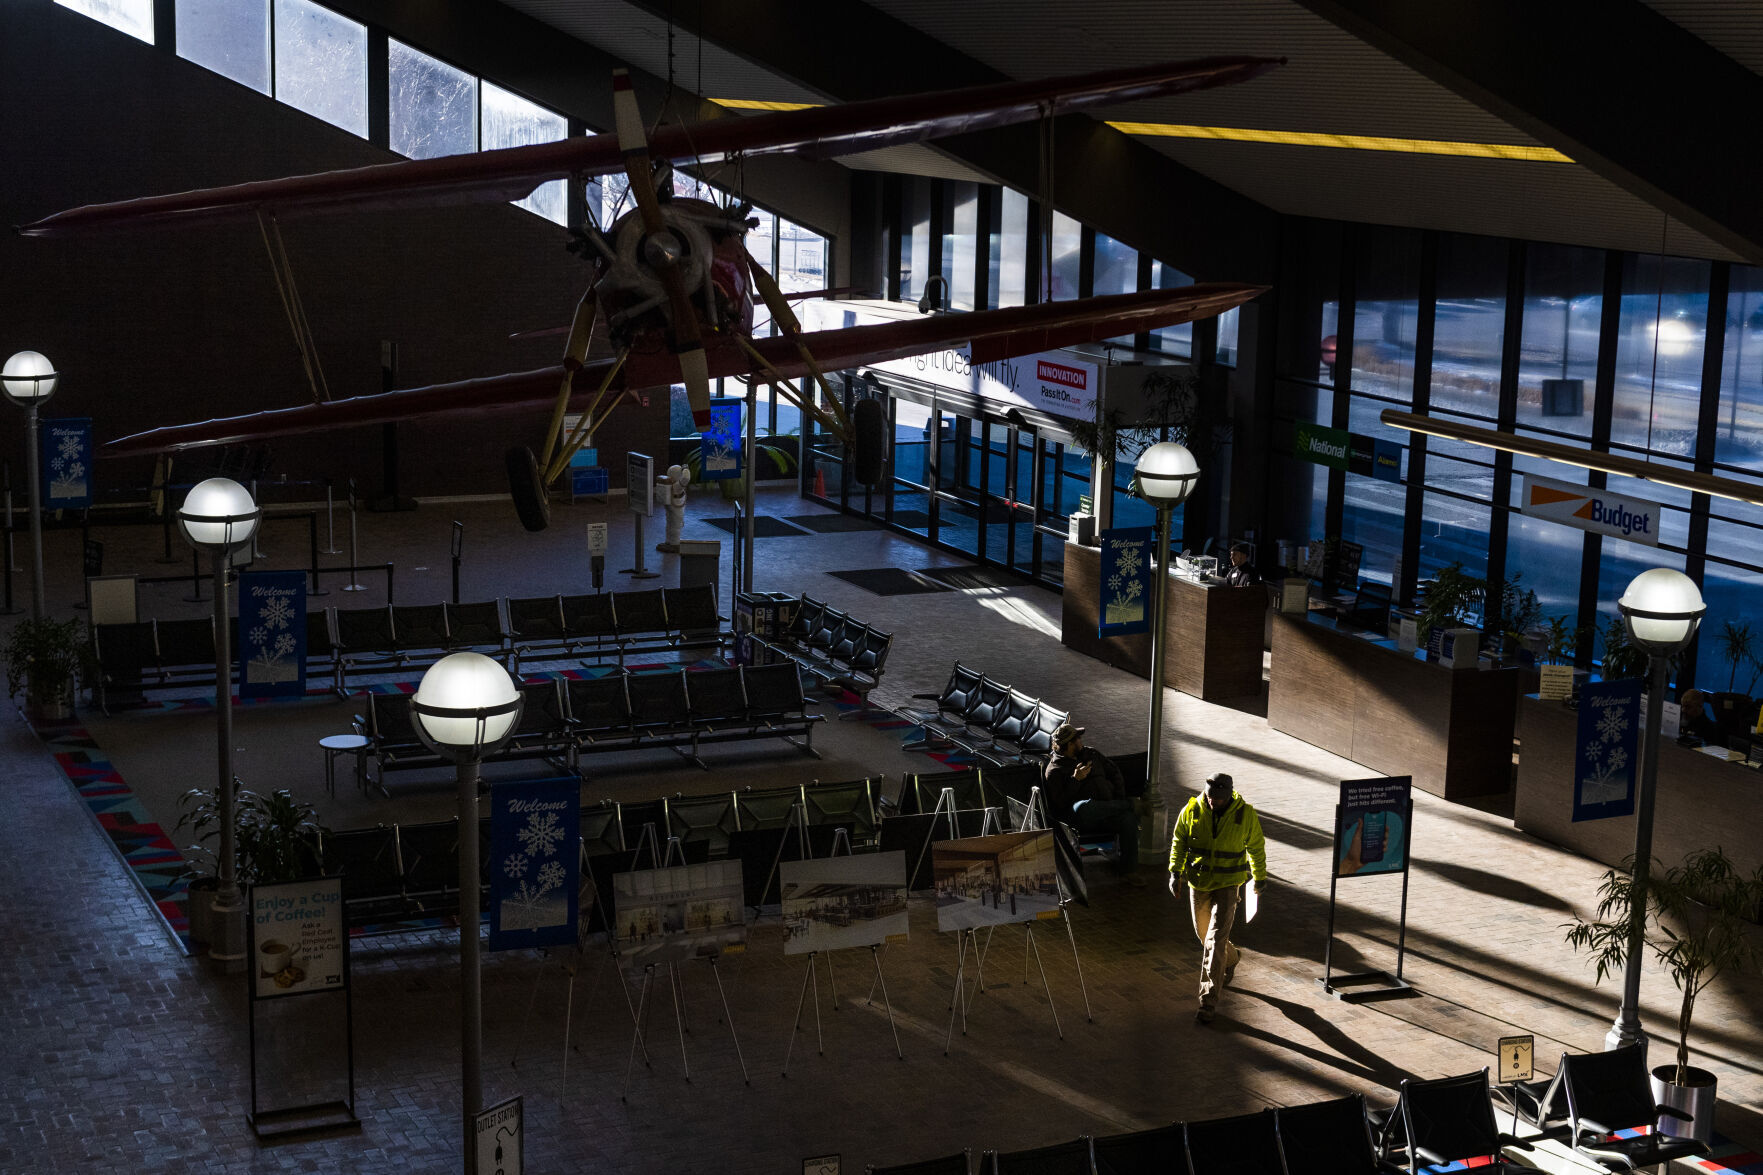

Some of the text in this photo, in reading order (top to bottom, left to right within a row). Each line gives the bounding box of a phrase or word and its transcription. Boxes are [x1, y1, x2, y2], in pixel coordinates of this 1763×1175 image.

[1001, 358, 1020, 393] fly.
[1039, 365, 1085, 385] INNOVATION
[51, 428, 85, 436] Welcome
[1309, 437, 1346, 459] National
[1592, 499, 1650, 535] Budget
[1110, 539, 1145, 549] Welcome
[251, 586, 297, 597] Welcome
[1590, 696, 1632, 708] Welcome
[508, 798, 568, 813] Welcome
[256, 891, 340, 910] Enjoy a Cup
[256, 905, 327, 924] of Coffee!
[477, 1104, 520, 1133] OUTLET STATION
